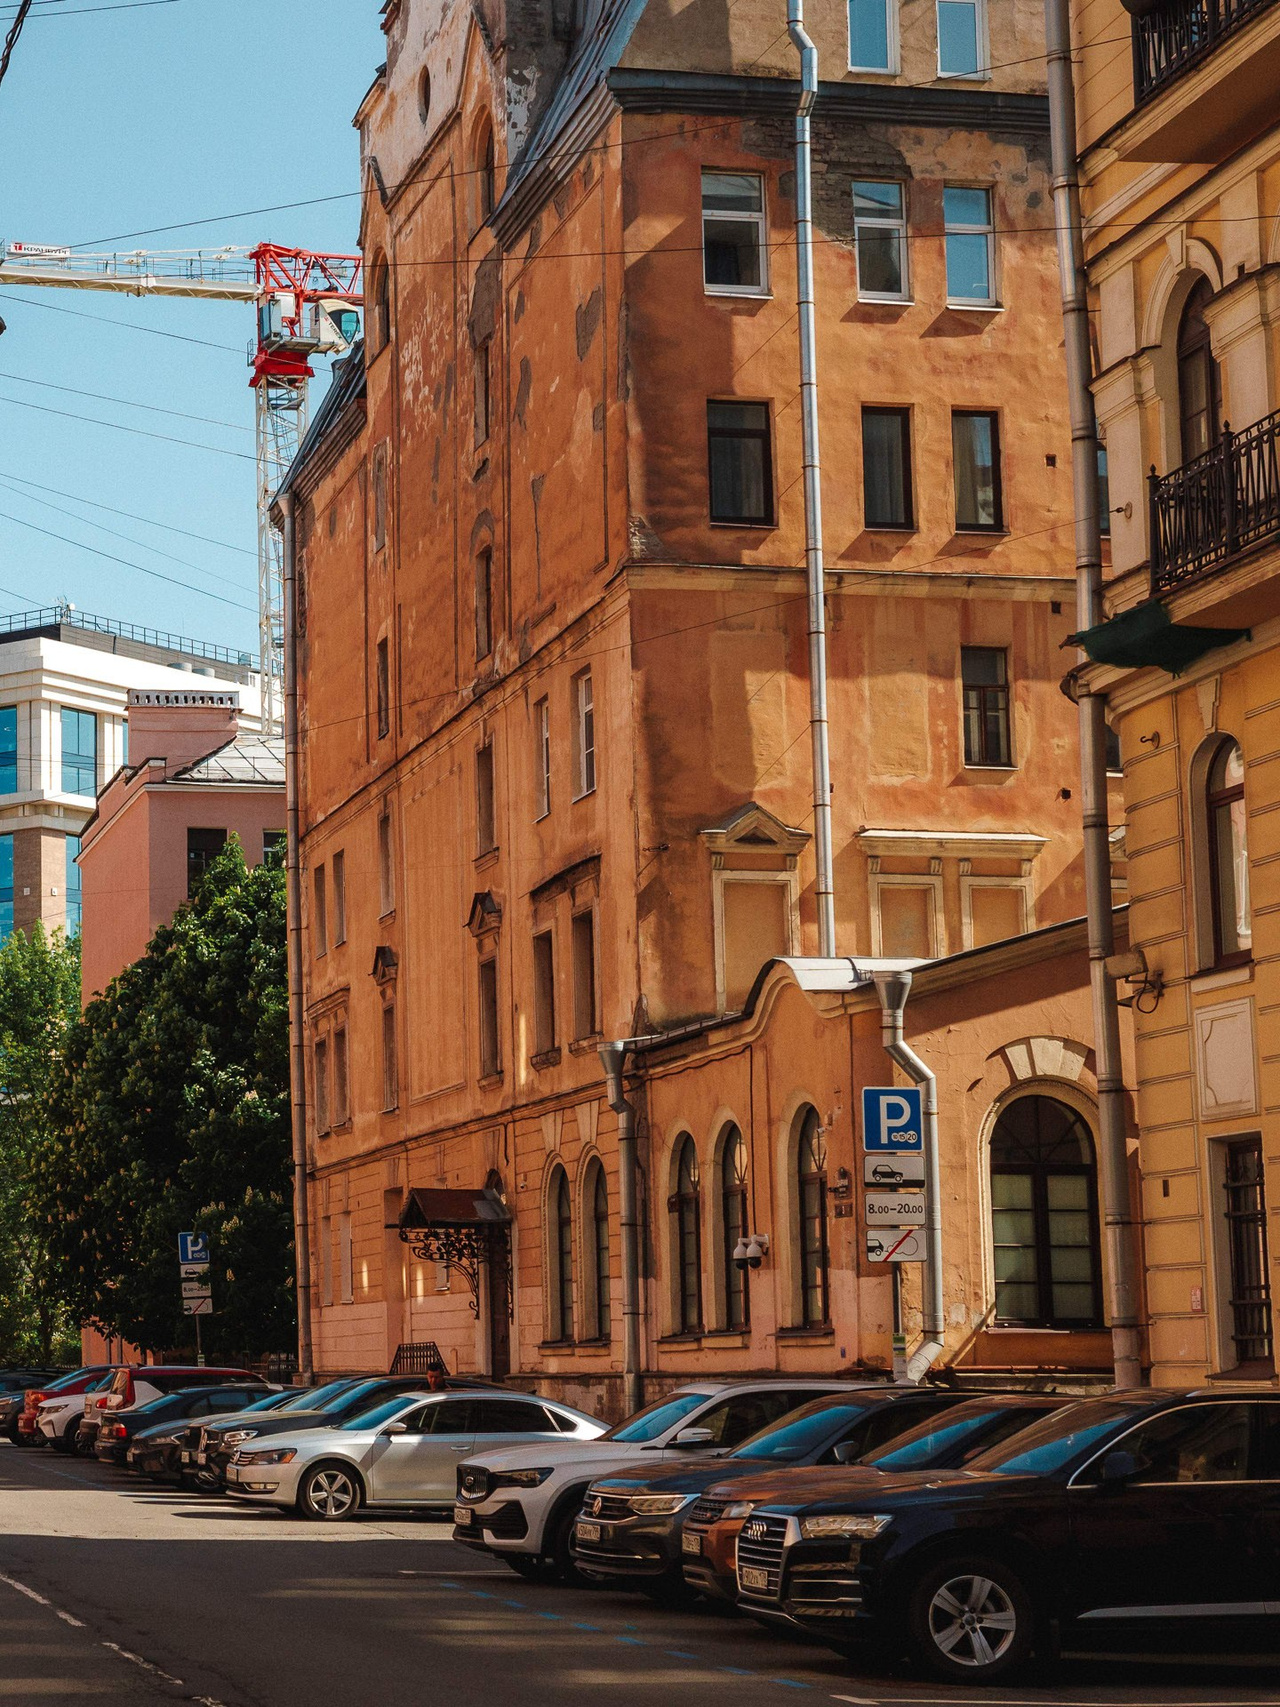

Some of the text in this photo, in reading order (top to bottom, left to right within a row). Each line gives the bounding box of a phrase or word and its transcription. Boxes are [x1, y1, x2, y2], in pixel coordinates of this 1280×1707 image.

[879, 1095, 911, 1144] P
[907, 1132, 917, 1141] 20
[867, 1203, 924, 1215] 8.00-20.00
[186, 1235, 204, 1260] P
